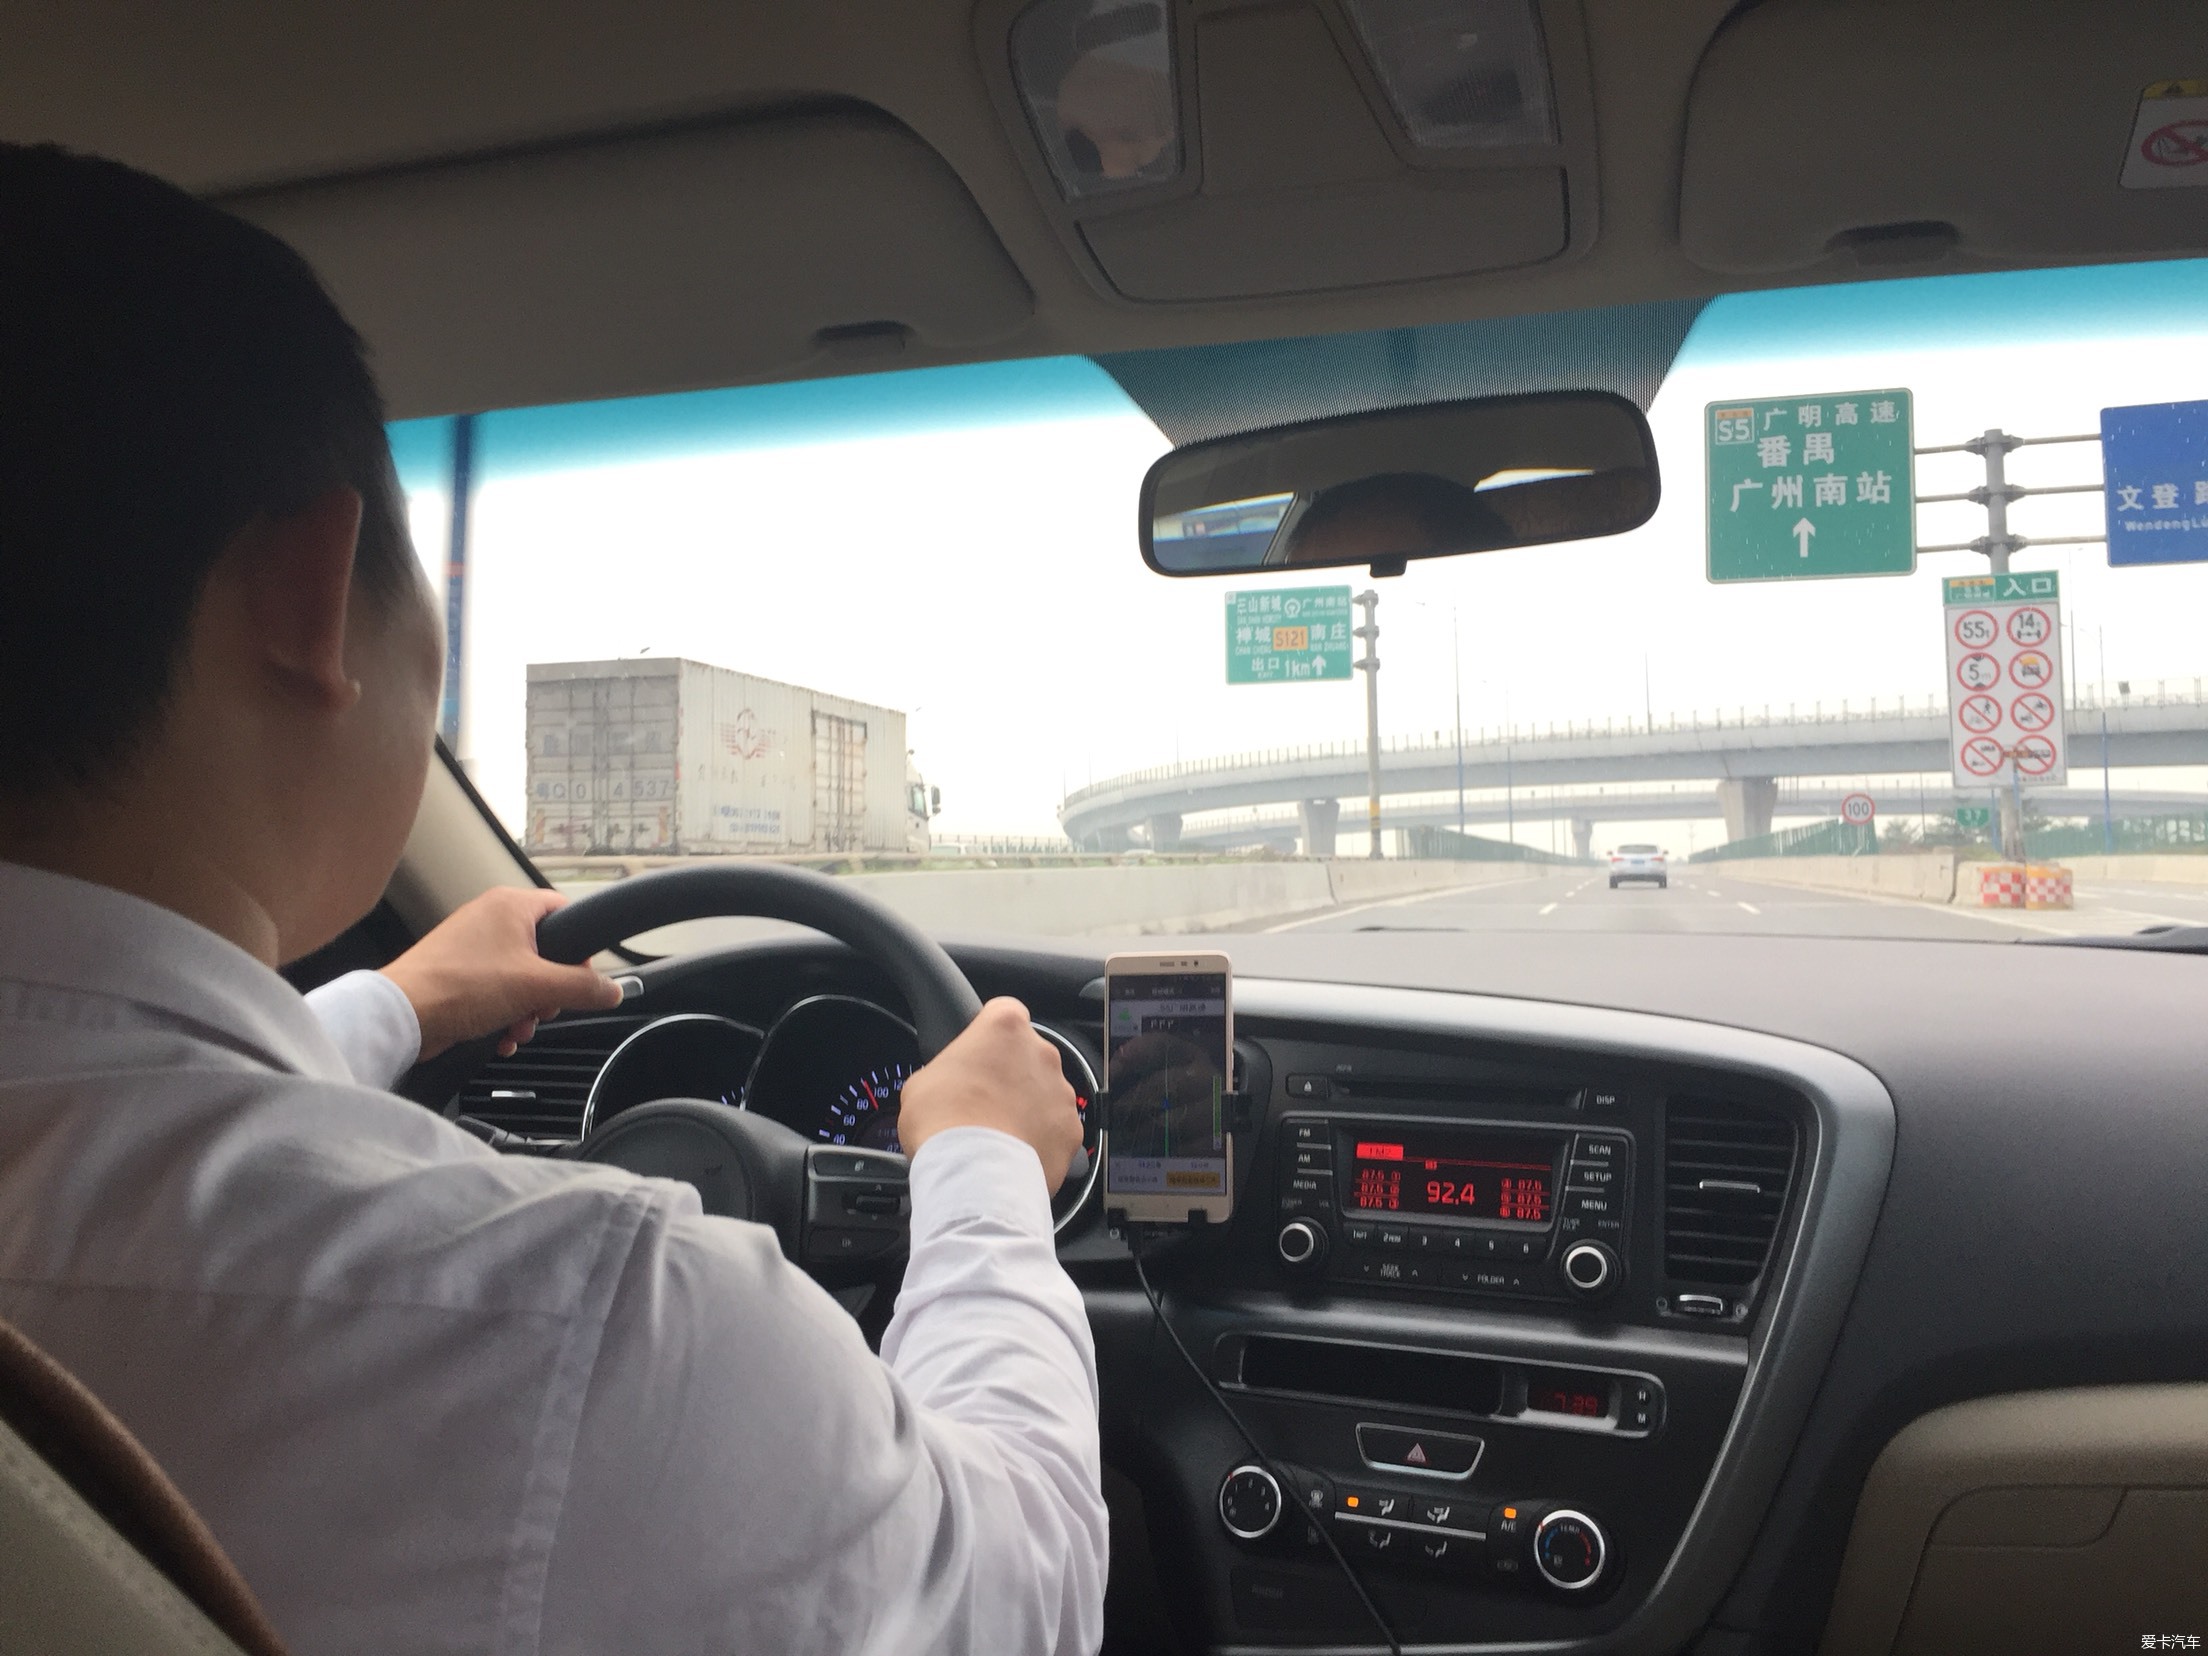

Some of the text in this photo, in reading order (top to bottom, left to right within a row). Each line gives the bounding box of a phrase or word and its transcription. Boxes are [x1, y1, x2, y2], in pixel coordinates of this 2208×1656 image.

[1763, 400, 1898, 431] 广明高速
[1718, 418, 1750, 441] S5
[1757, 432, 1836, 468] 番禺
[1730, 470, 1893, 512] 广州南站
[2002, 577, 2052, 597] 入口
[1310, 622, 1347, 641] 南庄
[1275, 629, 1305, 648] S121
[1252, 657, 1280, 671] 出口
[1848, 801, 1870, 817] 100
[874, 1086, 889, 1098] 100
[856, 1098, 869, 1111] 80
[843, 1114, 856, 1126] 60
[833, 1133, 846, 1145] 40
[1298, 1128, 1312, 1137] FM
[1588, 1144, 1612, 1156] SCAN
[1298, 1154, 1311, 1163] AM
[1583, 1171, 1612, 1183] SETUP
[1293, 1180, 1317, 1190] MEDIA
[1426, 1181, 1475, 1206] 92.4
[1581, 1199, 1608, 1211] MENU
[1638, 1391, 1646, 1401] H
[1638, 1413, 1647, 1424] M
[1500, 1520, 1517, 1533] A/C
